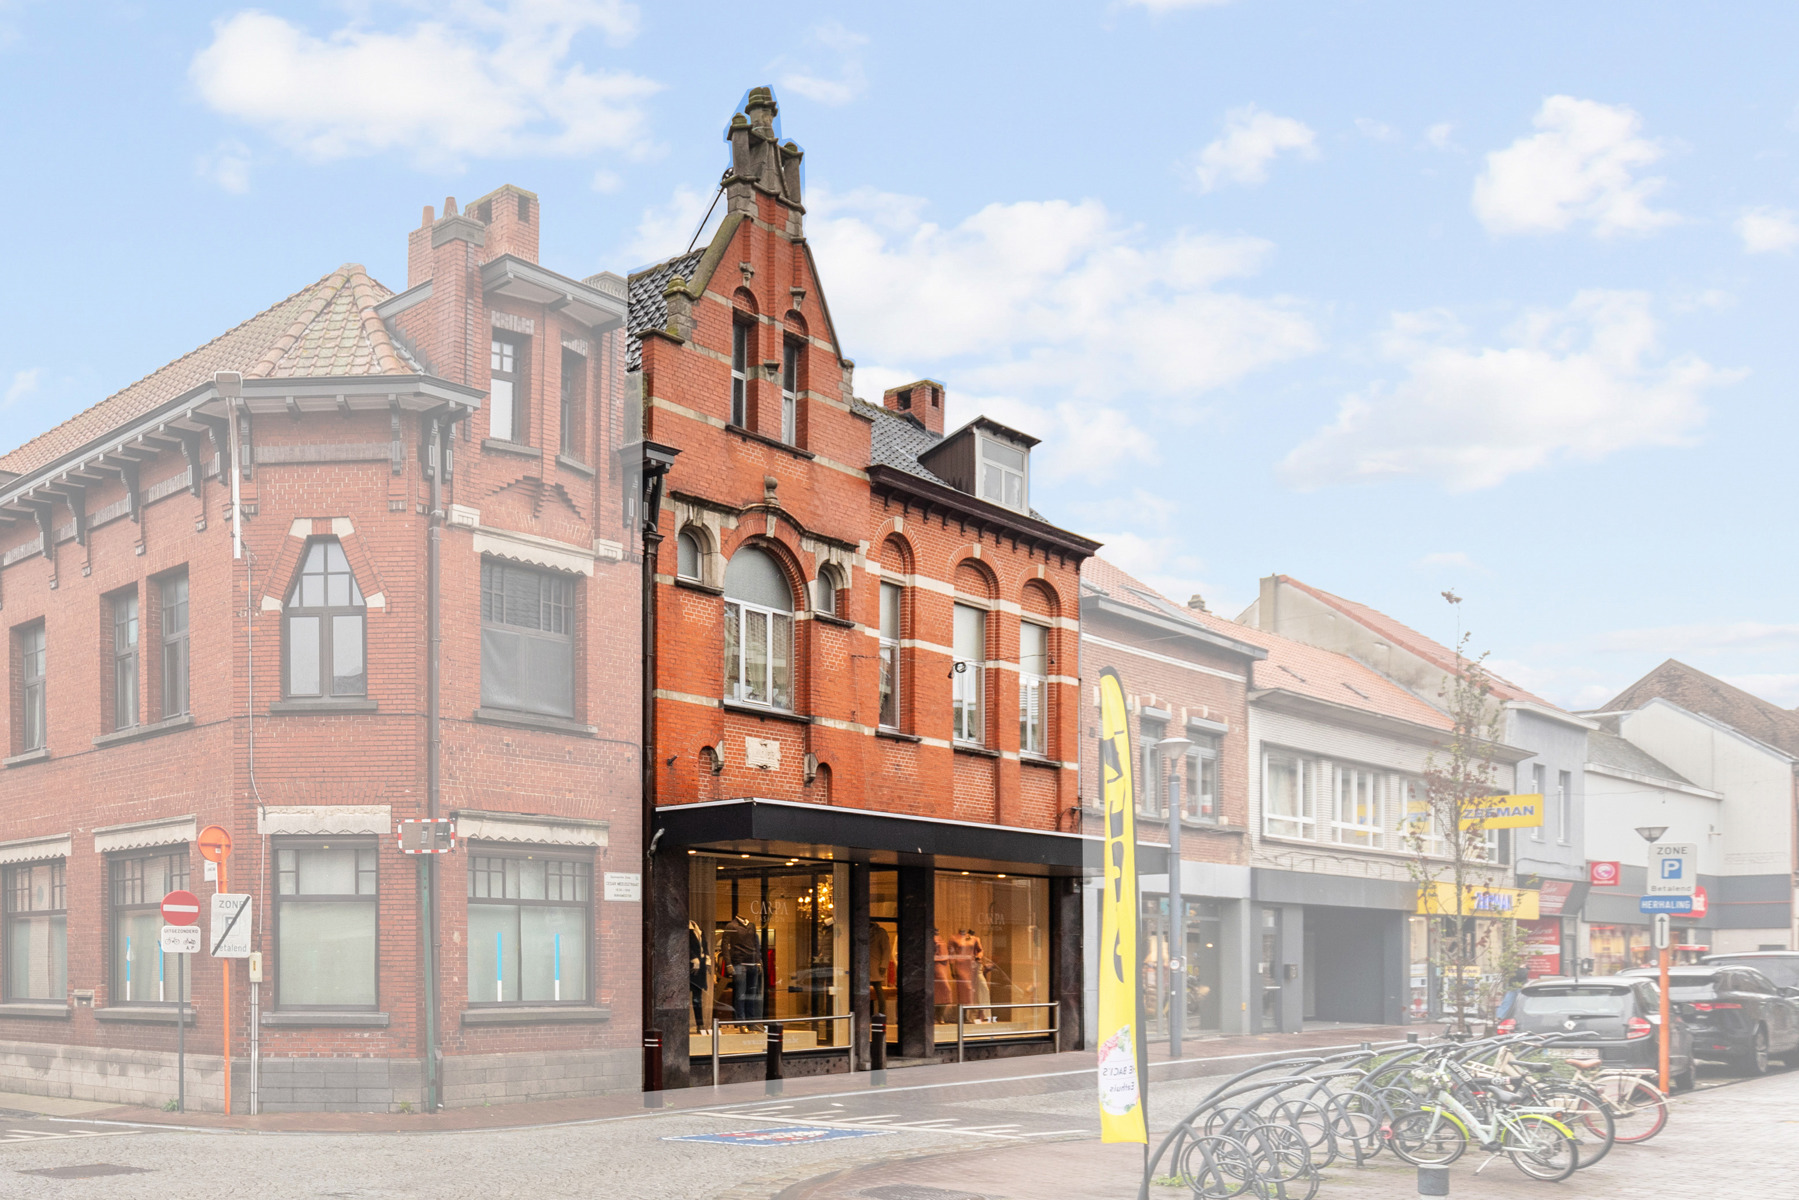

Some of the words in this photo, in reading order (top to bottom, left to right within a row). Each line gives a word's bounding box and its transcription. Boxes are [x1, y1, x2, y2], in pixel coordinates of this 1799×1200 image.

[1462, 805, 1534, 820] ZEEMAN
[1656, 846, 1688, 855] ZONE
[1663, 860, 1680, 878] P
[750, 900, 789, 916] CARPA
[1641, 900, 1691, 909] HERHALING
